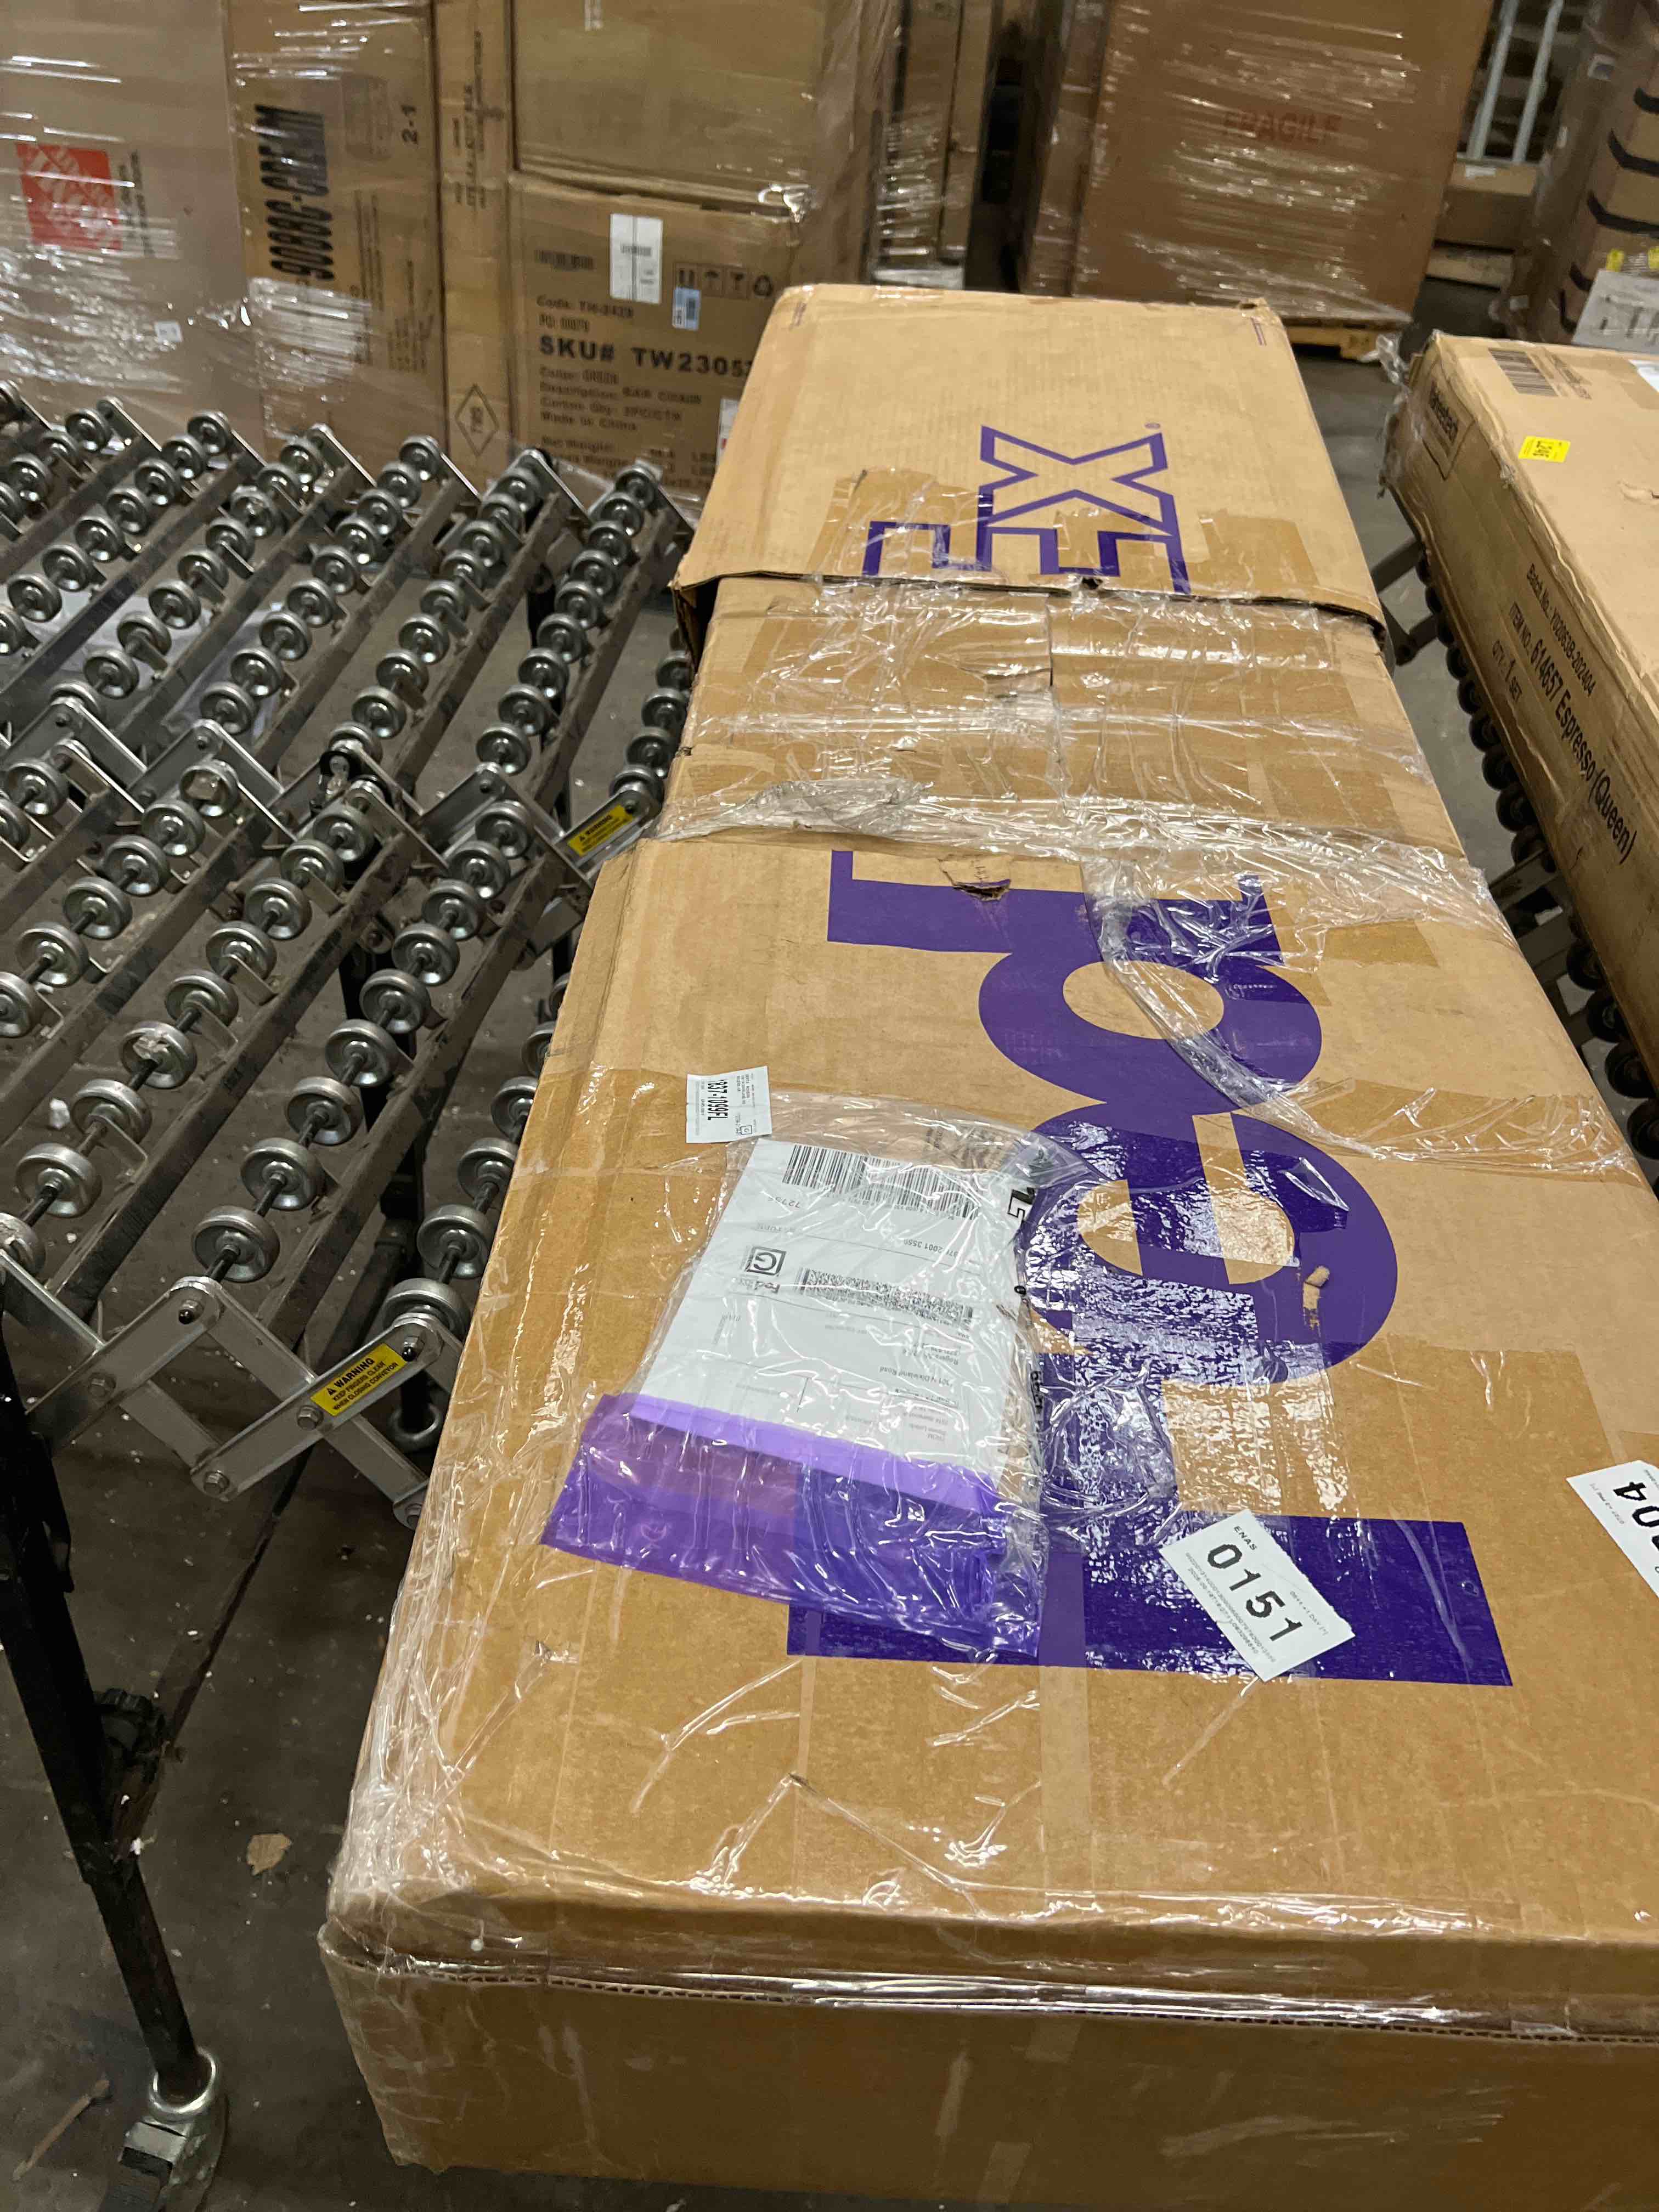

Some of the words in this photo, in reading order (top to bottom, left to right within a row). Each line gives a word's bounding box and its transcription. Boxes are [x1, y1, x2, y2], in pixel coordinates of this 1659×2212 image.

[540, 334, 615, 363] SKU#
[1531, 639, 1563, 703] 614657
[1555, 689, 1596, 781] Espresso
[1589, 769, 1637, 865] (Queen)
[707, 1079, 729, 1121] 1837-1099FL
[334, 1357, 375, 1388] WARNING
[333, 1390, 347, 1401] KEEP
[333, 1399, 349, 1410] WHEN
[347, 1381, 370, 1400] CLOSING
[1613, 1482, 1659, 1551] 04
[1234, 1526, 1257, 1551] ENAS
[1207, 1543, 1303, 1641] 0151
